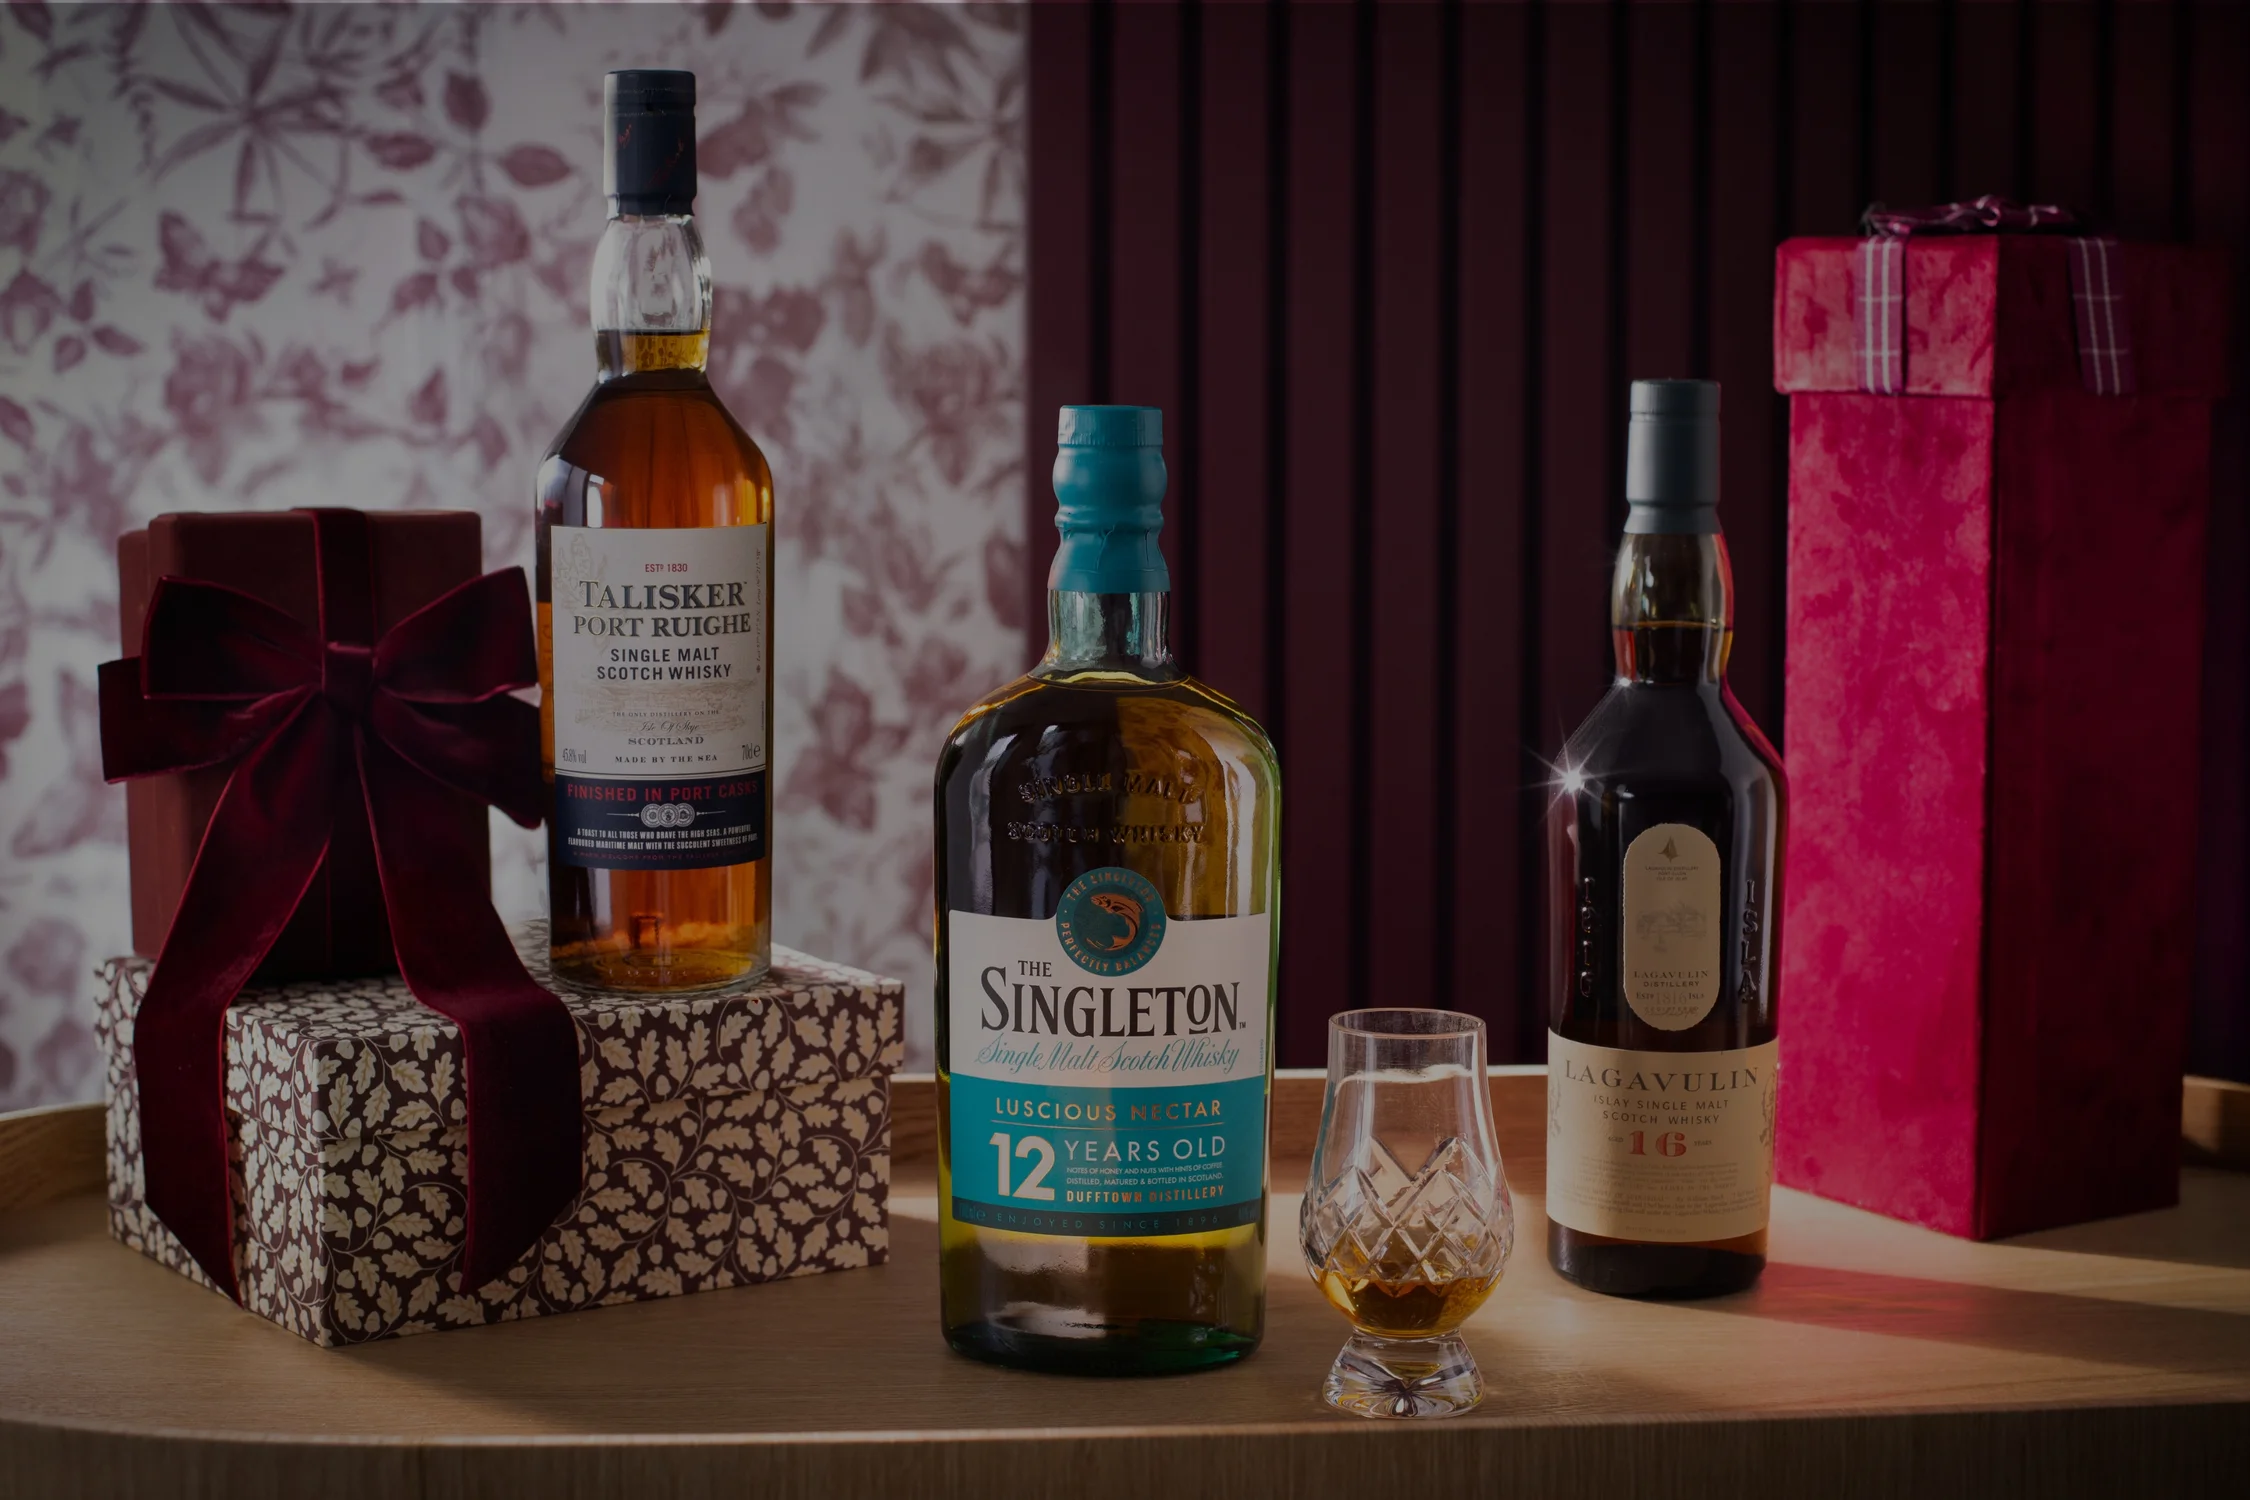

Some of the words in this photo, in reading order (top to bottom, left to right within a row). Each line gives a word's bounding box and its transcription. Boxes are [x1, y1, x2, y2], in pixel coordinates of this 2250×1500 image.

[667, 563, 688, 572] 1830
[579, 580, 746, 611] TALISKER
[574, 615, 644, 638] PORT
[651, 612, 751, 638] RUIGHE
[610, 648, 670, 663] SINGLE
[678, 646, 720, 662] MALT
[597, 666, 663, 680] SCOTCH
[669, 664, 732, 680] WHISKY
[650, 710, 692, 718] DISTILLERY
[628, 736, 704, 746] SCOTLAND
[578, 750, 587, 764] vol
[615, 756, 646, 764] MADE
[652, 756, 666, 764] BY
[698, 754, 718, 762] SEA
[567, 783, 637, 801] FINISHED
[644, 787, 662, 802] IN
[670, 786, 712, 801] PORT
[718, 780, 758, 798] CASKS
[576, 827, 581, 836] A
[581, 828, 598, 838] TOAST
[599, 830, 606, 838] TO
[607, 830, 618, 838] ALL
[619, 830, 638, 839] THOSE
[640, 831, 655, 840] WHO
[656, 830, 676, 839] BRAVE
[678, 830, 688, 838] THE
[690, 829, 705, 838] HIGH
[596, 840, 626, 850] MARITIME
[627, 841, 644, 850] MALT
[645, 841, 662, 850] WITH
[664, 841, 675, 850] THE
[676, 840, 710, 849] SUCCULENT
[1066, 880, 1087, 901] THE
[1060, 921, 1110, 972] PERFECTLY
[1115, 922, 1162, 972] BALANCED
[1017, 960, 1052, 978] THE
[1633, 970, 1710, 979] LAGAVULIN
[1643, 980, 1700, 988] DISTILLERY
[980, 966, 1241, 1038] SINGLETON
[974, 1033, 1048, 1074] Single
[1040, 1040, 1100, 1072] Malt
[1096, 1040, 1170, 1073] Scotch
[1170, 1036, 1241, 1074] Whisky
[1565, 1059, 1759, 1093] LAGAVULIN
[995, 1096, 1117, 1121] LUSCIOUS
[1130, 1099, 1222, 1121] NECTAR
[1593, 1094, 1630, 1108] ISLAY
[1637, 1100, 1687, 1111] SINGLE
[1695, 1099, 1730, 1110] MALT
[1602, 1110, 1658, 1124] SCOTCH
[1668, 1114, 1720, 1125] WHISKY
[1628, 1130, 1687, 1158] 16
[988, 1131, 1056, 1202] 12
[1064, 1139, 1160, 1162] YEARS
[1172, 1135, 1226, 1161] OLD
[1175, 1165, 1192, 1173] HINTS
[1192, 1164, 1202, 1172] OF
[1066, 1177, 1101, 1186] DISTILLED,
[1104, 1178, 1138, 1186] MATURED
[1147, 1176, 1177, 1185] BOTTLED
[1188, 1172, 1224, 1183] SCOTLAND.
[1066, 1190, 1142, 1203] DUFFTOWN
[1150, 1184, 1224, 1203] DISTILLERY
[996, 1212, 1082, 1230] ENJOYED
[1099, 1220, 1160, 1230] SINCE
[1176, 1214, 1218, 1228] 1896
